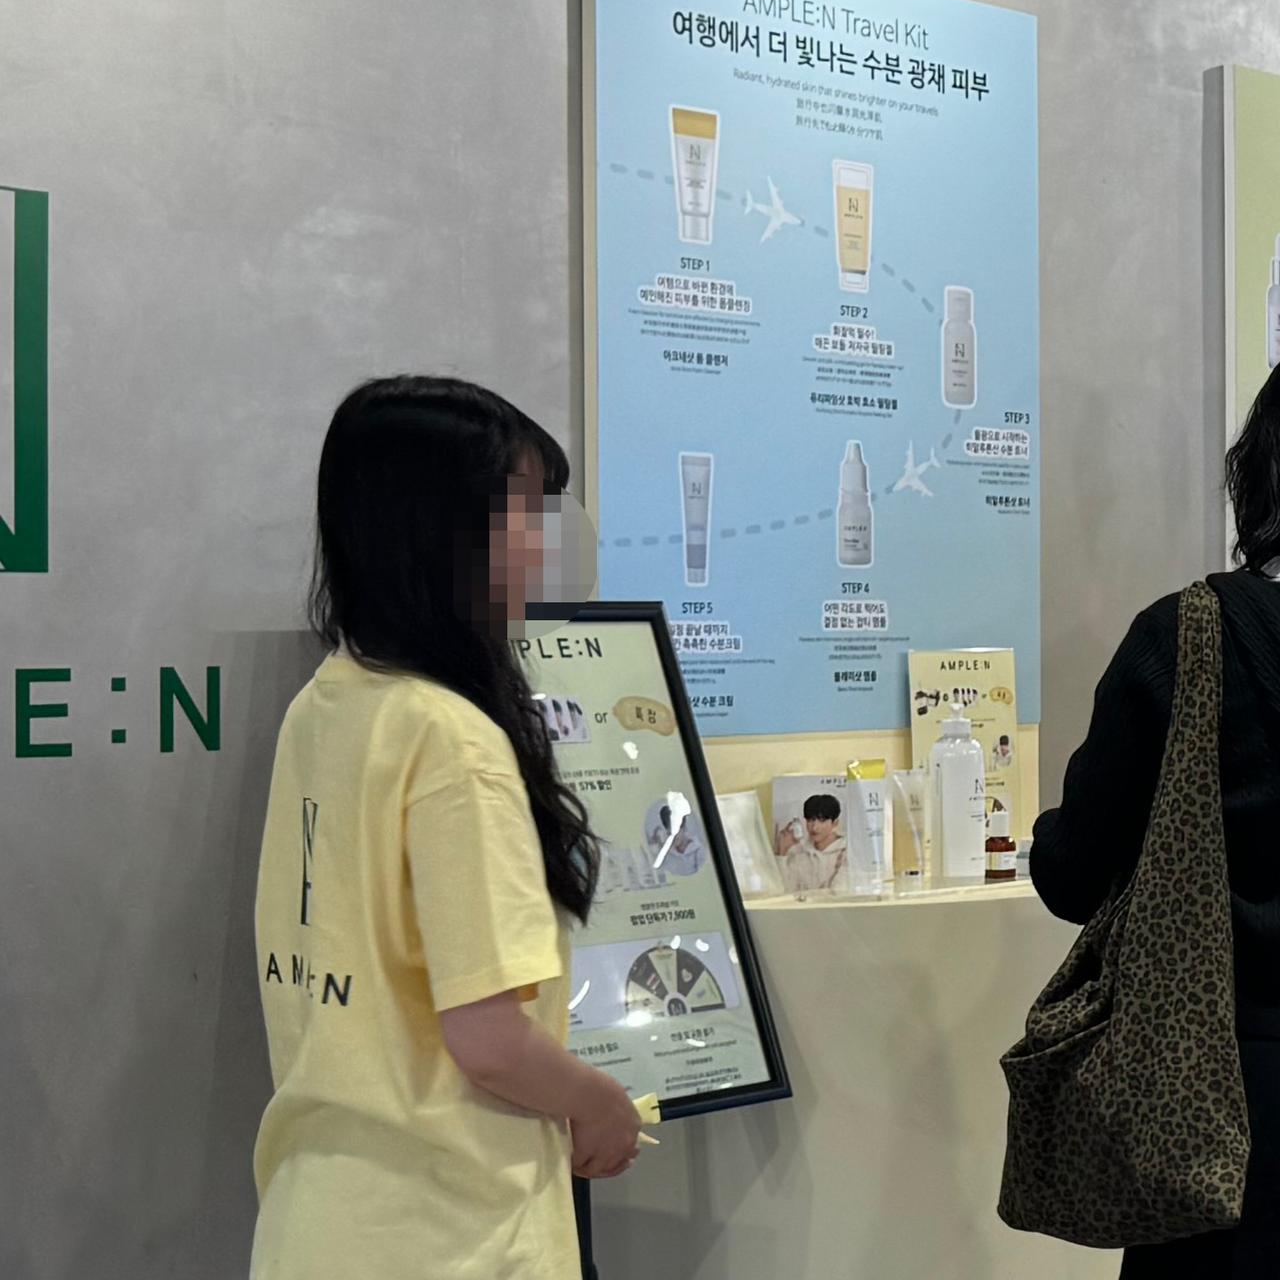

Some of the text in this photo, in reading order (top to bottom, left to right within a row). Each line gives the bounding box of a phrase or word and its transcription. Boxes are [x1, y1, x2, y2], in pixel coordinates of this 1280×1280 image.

[841, 8, 899, 43] Travel
[904, 22, 929, 50] Kit
[673, 11, 990, 101] 여행에서 더 빛나는 수분 광채 피부
[680, 257, 703, 271] STEP
[840, 305, 868, 319] STEP 2
[1005, 411, 1024, 424] STEP
[841, 582, 862, 594] STEP
[682, 602, 713, 614] STEP 5
[594, 710, 608, 724] or
